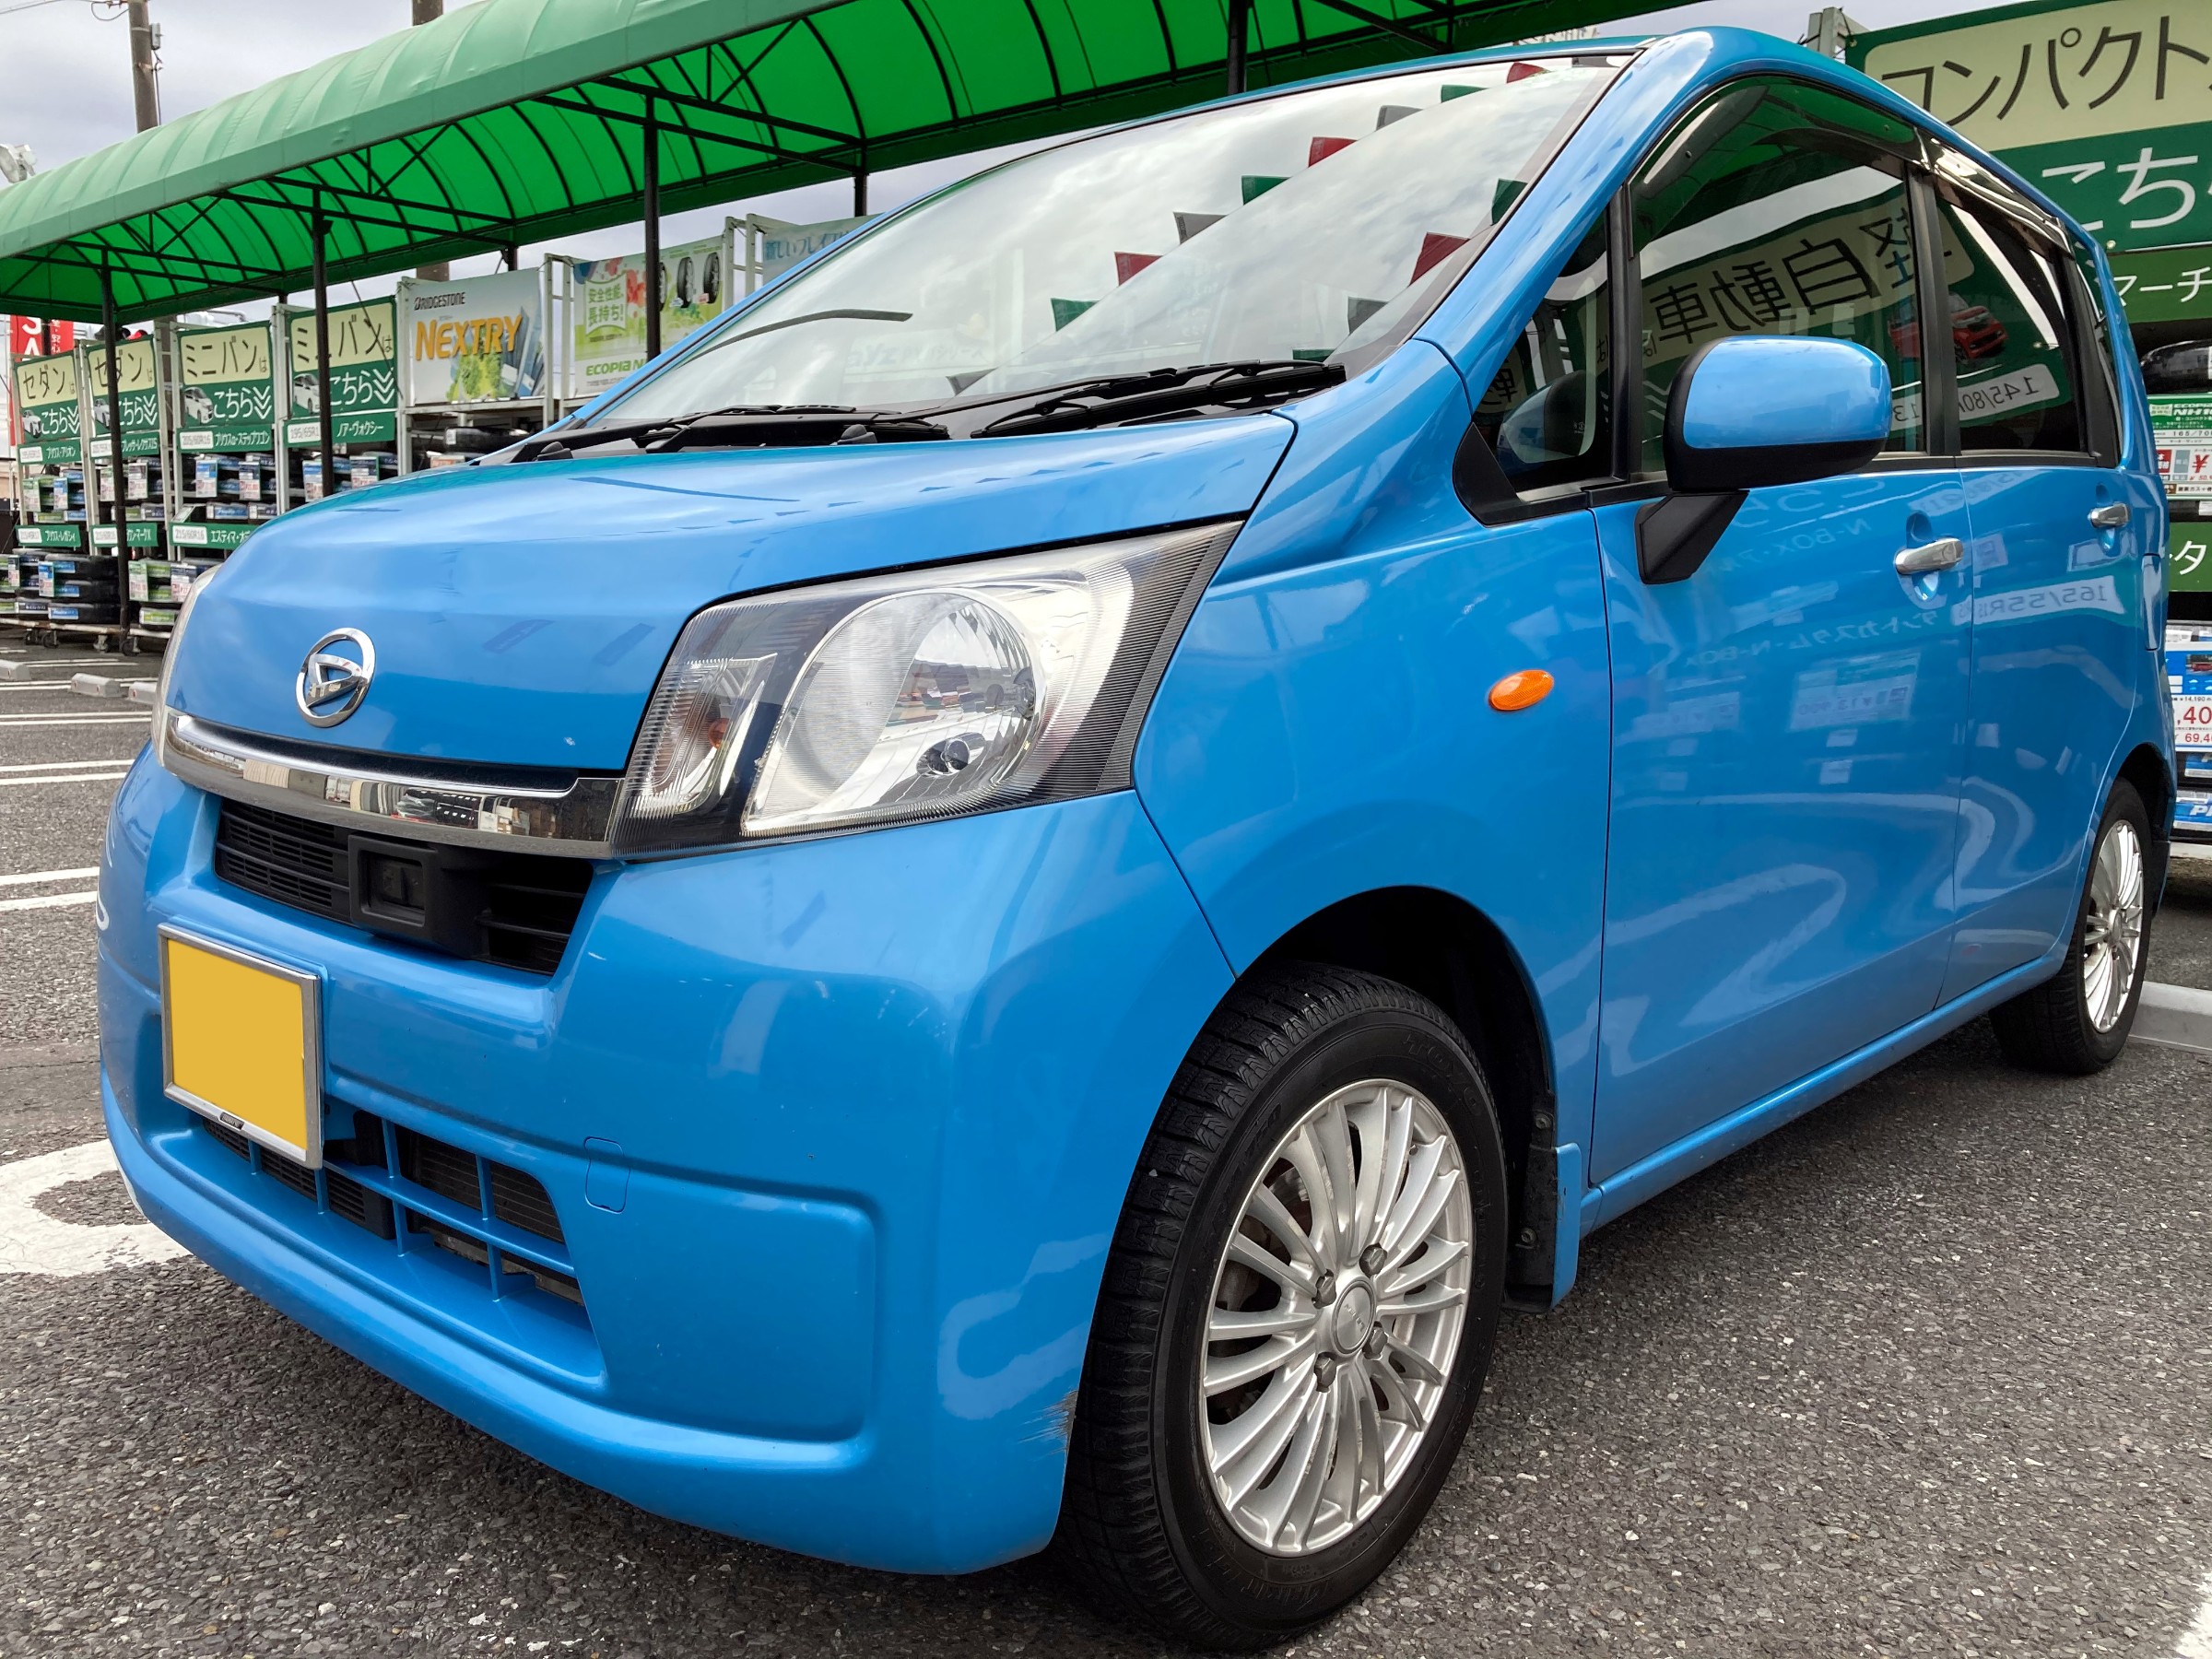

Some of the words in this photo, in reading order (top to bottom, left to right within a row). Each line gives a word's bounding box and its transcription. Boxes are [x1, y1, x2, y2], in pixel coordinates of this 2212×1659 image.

[1880, 15, 2212, 127] コンパクト
[2042, 147, 2212, 231] こち
[414, 292, 465, 311] BRIDGESTONE
[186, 335, 267, 378] ミニバンは
[298, 314, 393, 363] ミバンは
[416, 313, 524, 361] NEXTRY
[41, 407, 68, 434] こちら
[214, 387, 253, 418] こちら
[2169, 540, 2207, 575] タ
